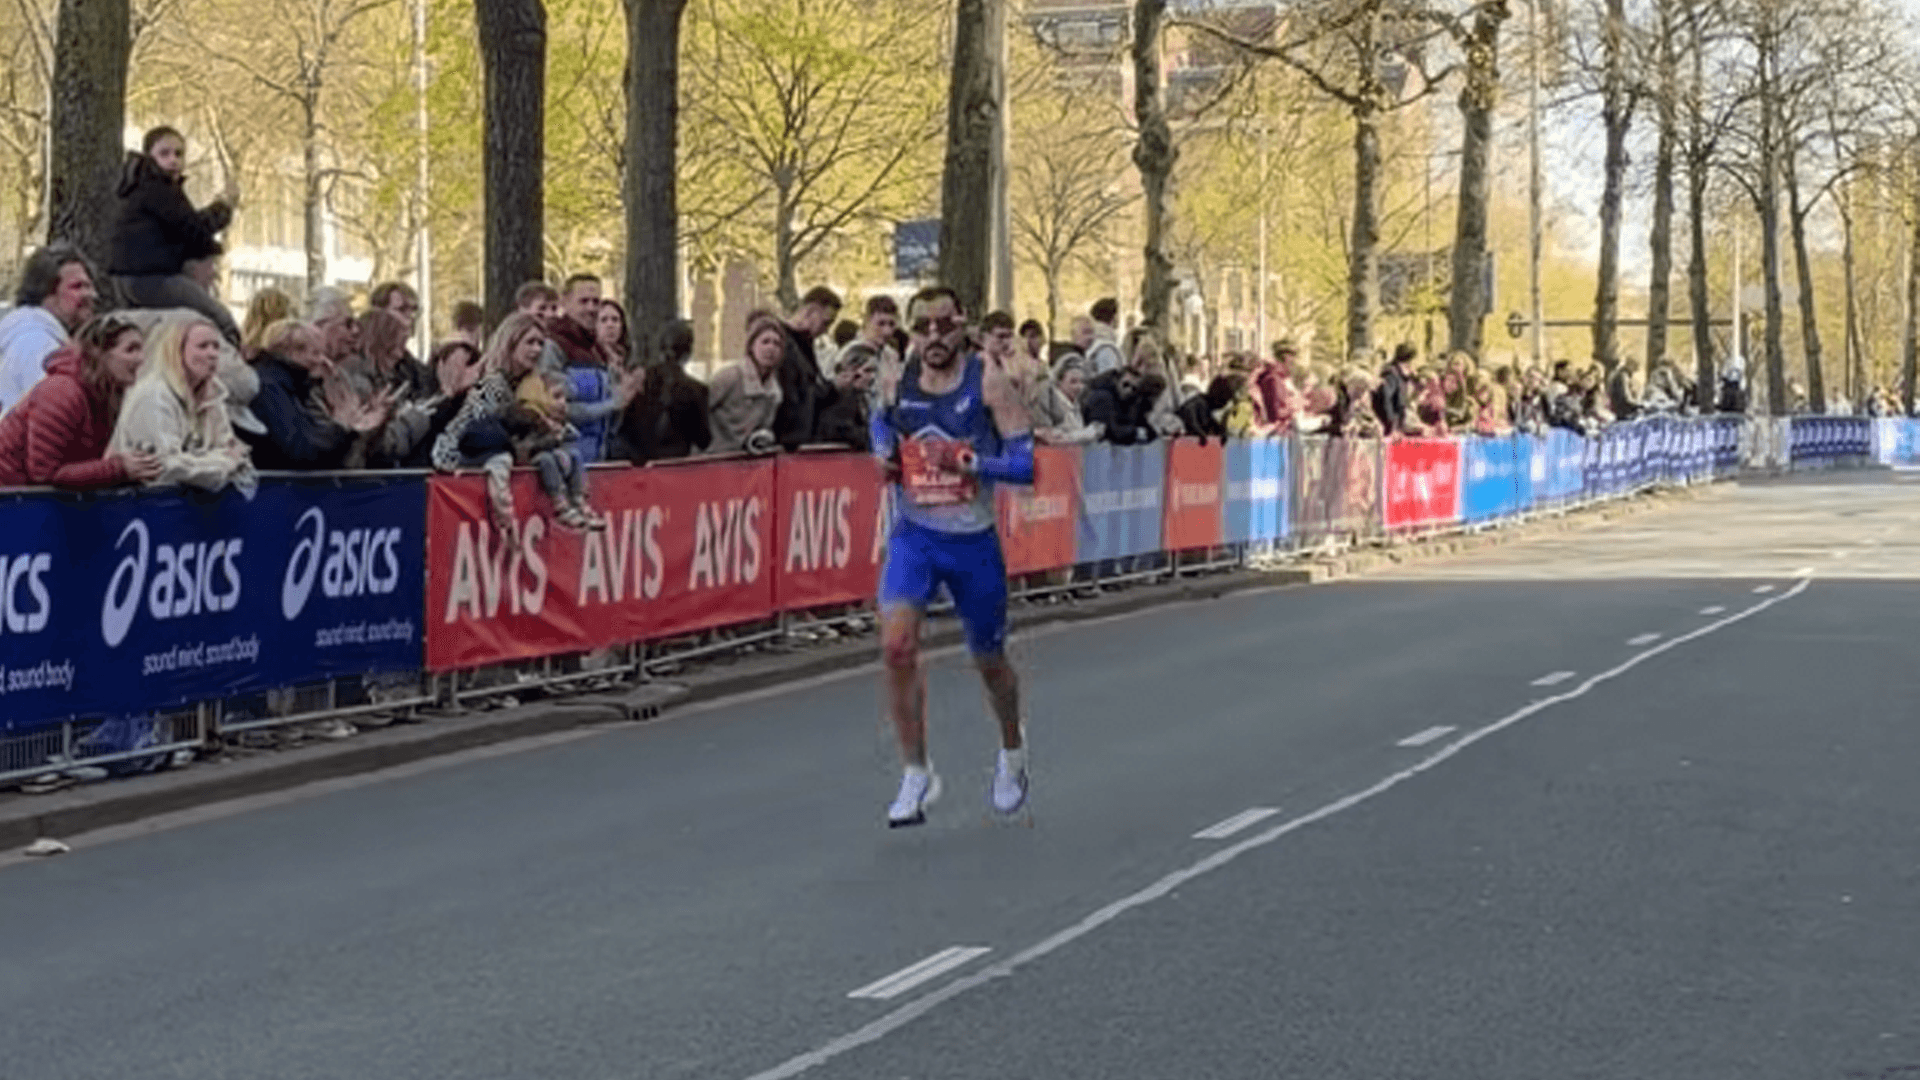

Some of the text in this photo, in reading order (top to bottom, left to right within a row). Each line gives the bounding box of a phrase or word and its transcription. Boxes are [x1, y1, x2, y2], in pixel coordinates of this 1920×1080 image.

[444, 514, 547, 624] AVIS
[579, 504, 664, 606] AVIS
[689, 496, 760, 591] AVIS
[785, 487, 850, 572] AVIS
[8, 659, 45, 692] sound
[46, 657, 75, 693] body
